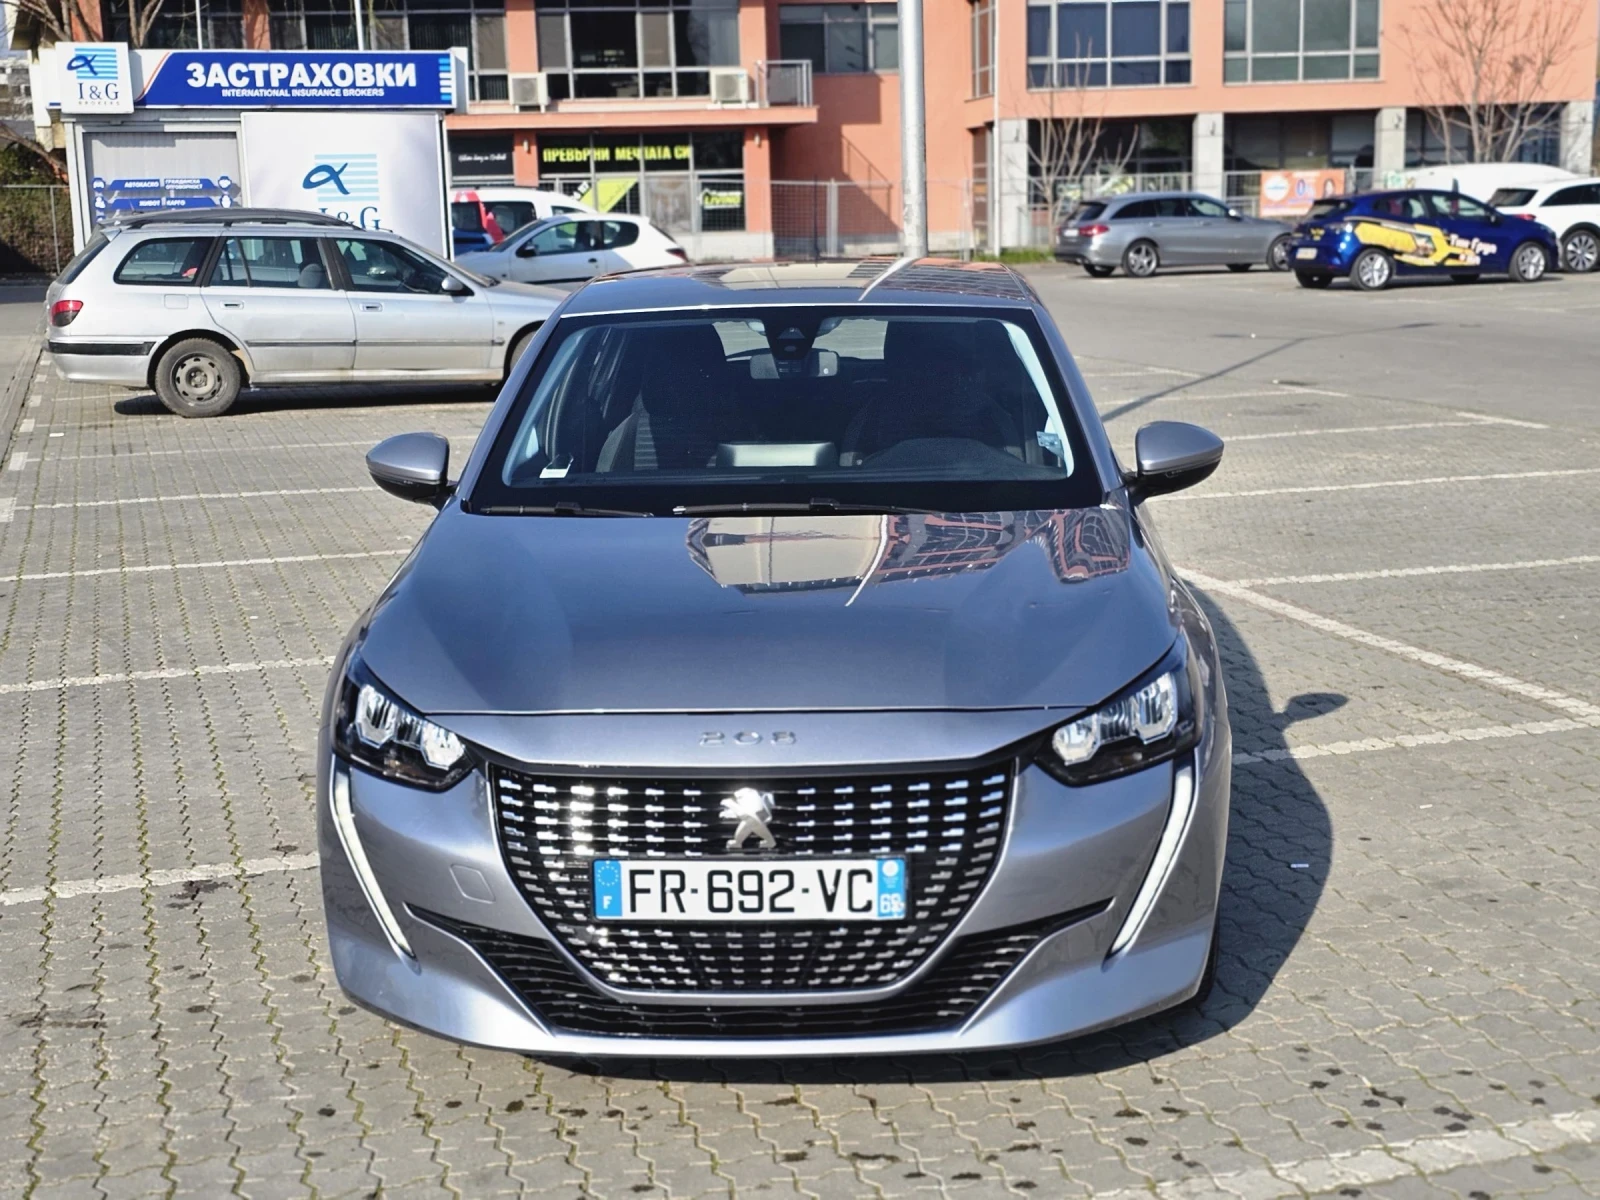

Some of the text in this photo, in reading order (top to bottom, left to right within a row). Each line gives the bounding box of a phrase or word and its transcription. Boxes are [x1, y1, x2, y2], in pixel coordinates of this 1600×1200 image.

[186, 62, 417, 88] ЗАСТРАХОВКИ
[221, 87, 385, 98] INTERNATIONAL INSURANCE BROKERS
[699, 731, 797, 747] 208
[628, 868, 873, 914] FR-692-VC
[602, 895, 613, 910] F
